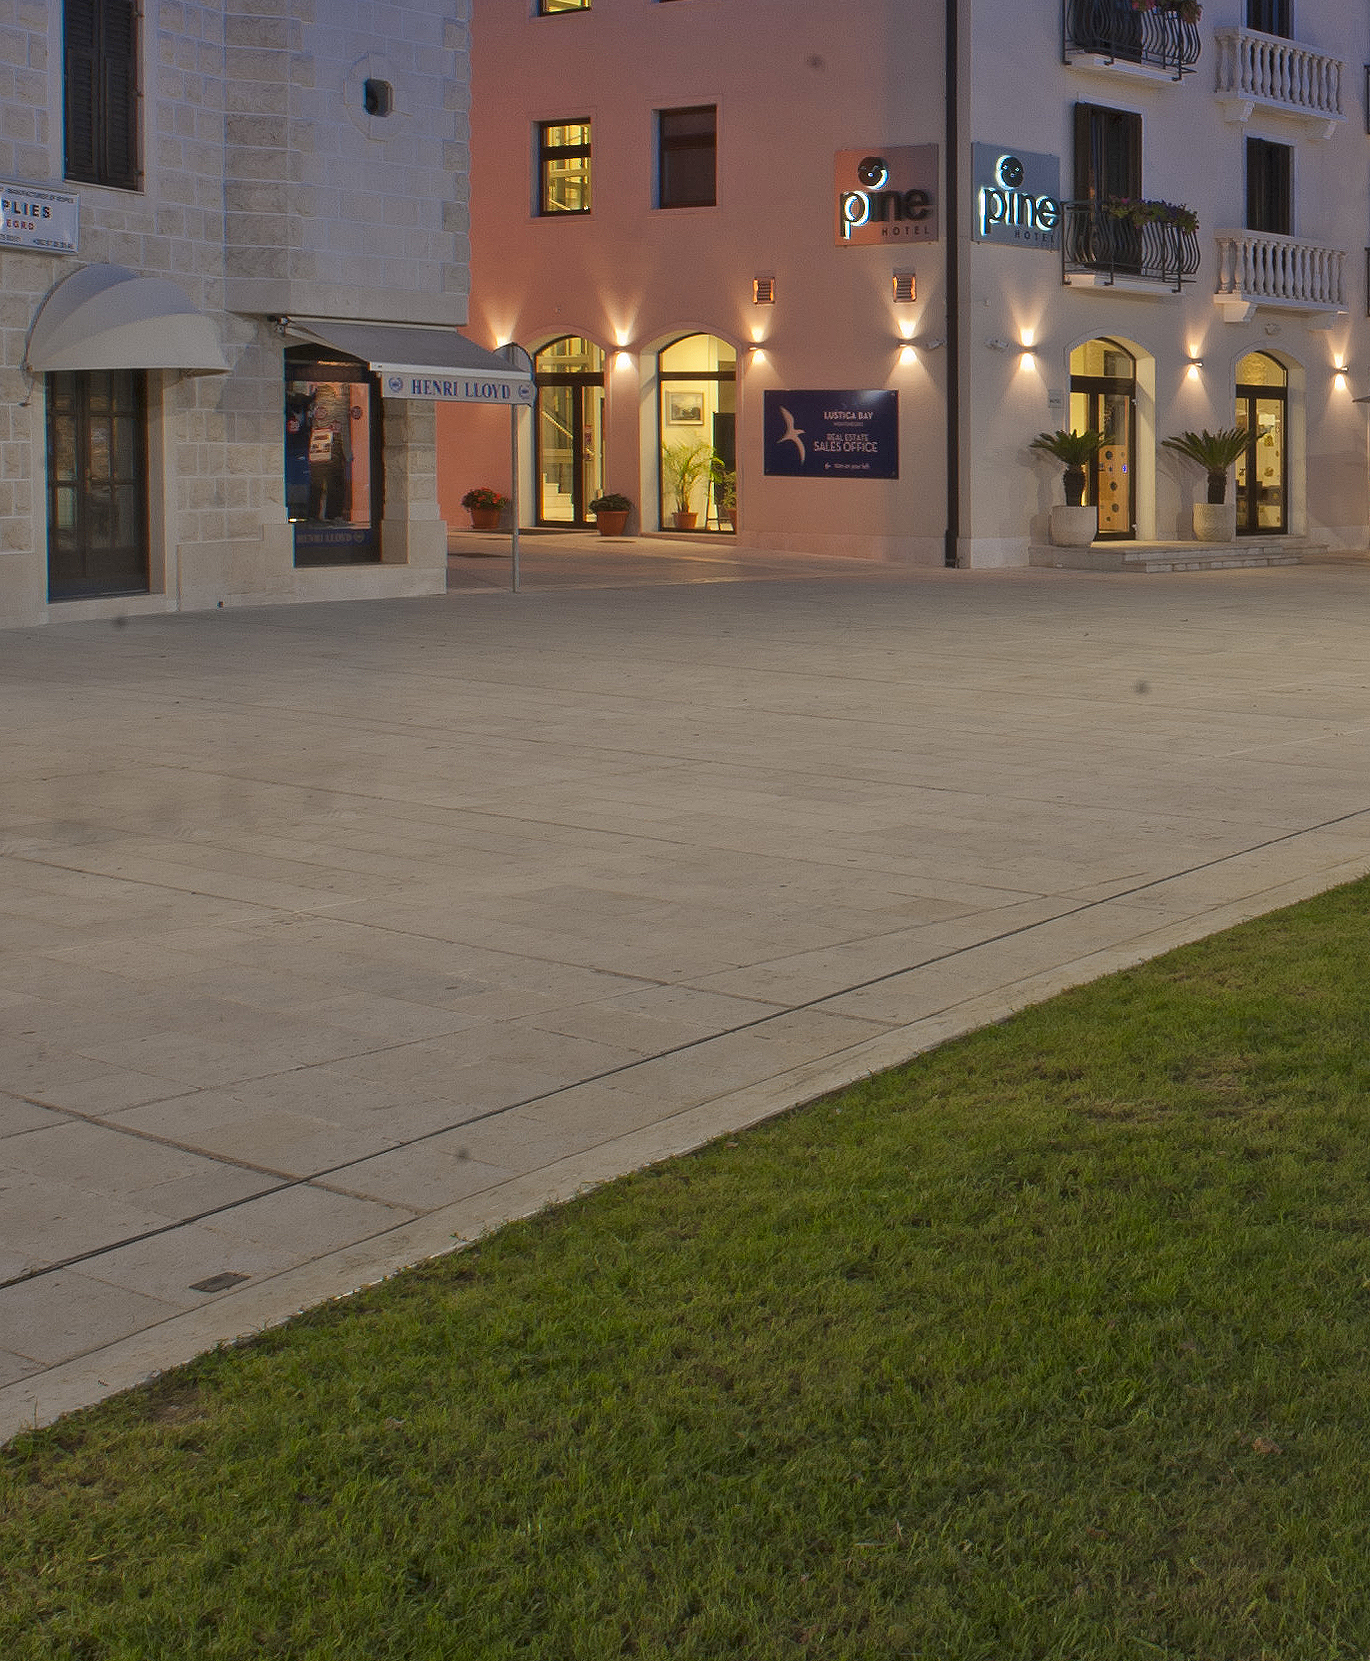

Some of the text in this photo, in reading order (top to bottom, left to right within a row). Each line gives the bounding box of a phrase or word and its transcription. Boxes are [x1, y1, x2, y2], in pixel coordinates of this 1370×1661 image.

[840, 156, 933, 240] pine
[978, 155, 1060, 237] pine
[881, 225, 930, 236] HOTEL
[1014, 230, 1055, 243] HOTEL
[411, 379, 511, 400] HENRI LLOYD
[814, 441, 878, 453] SALES OFFICE
